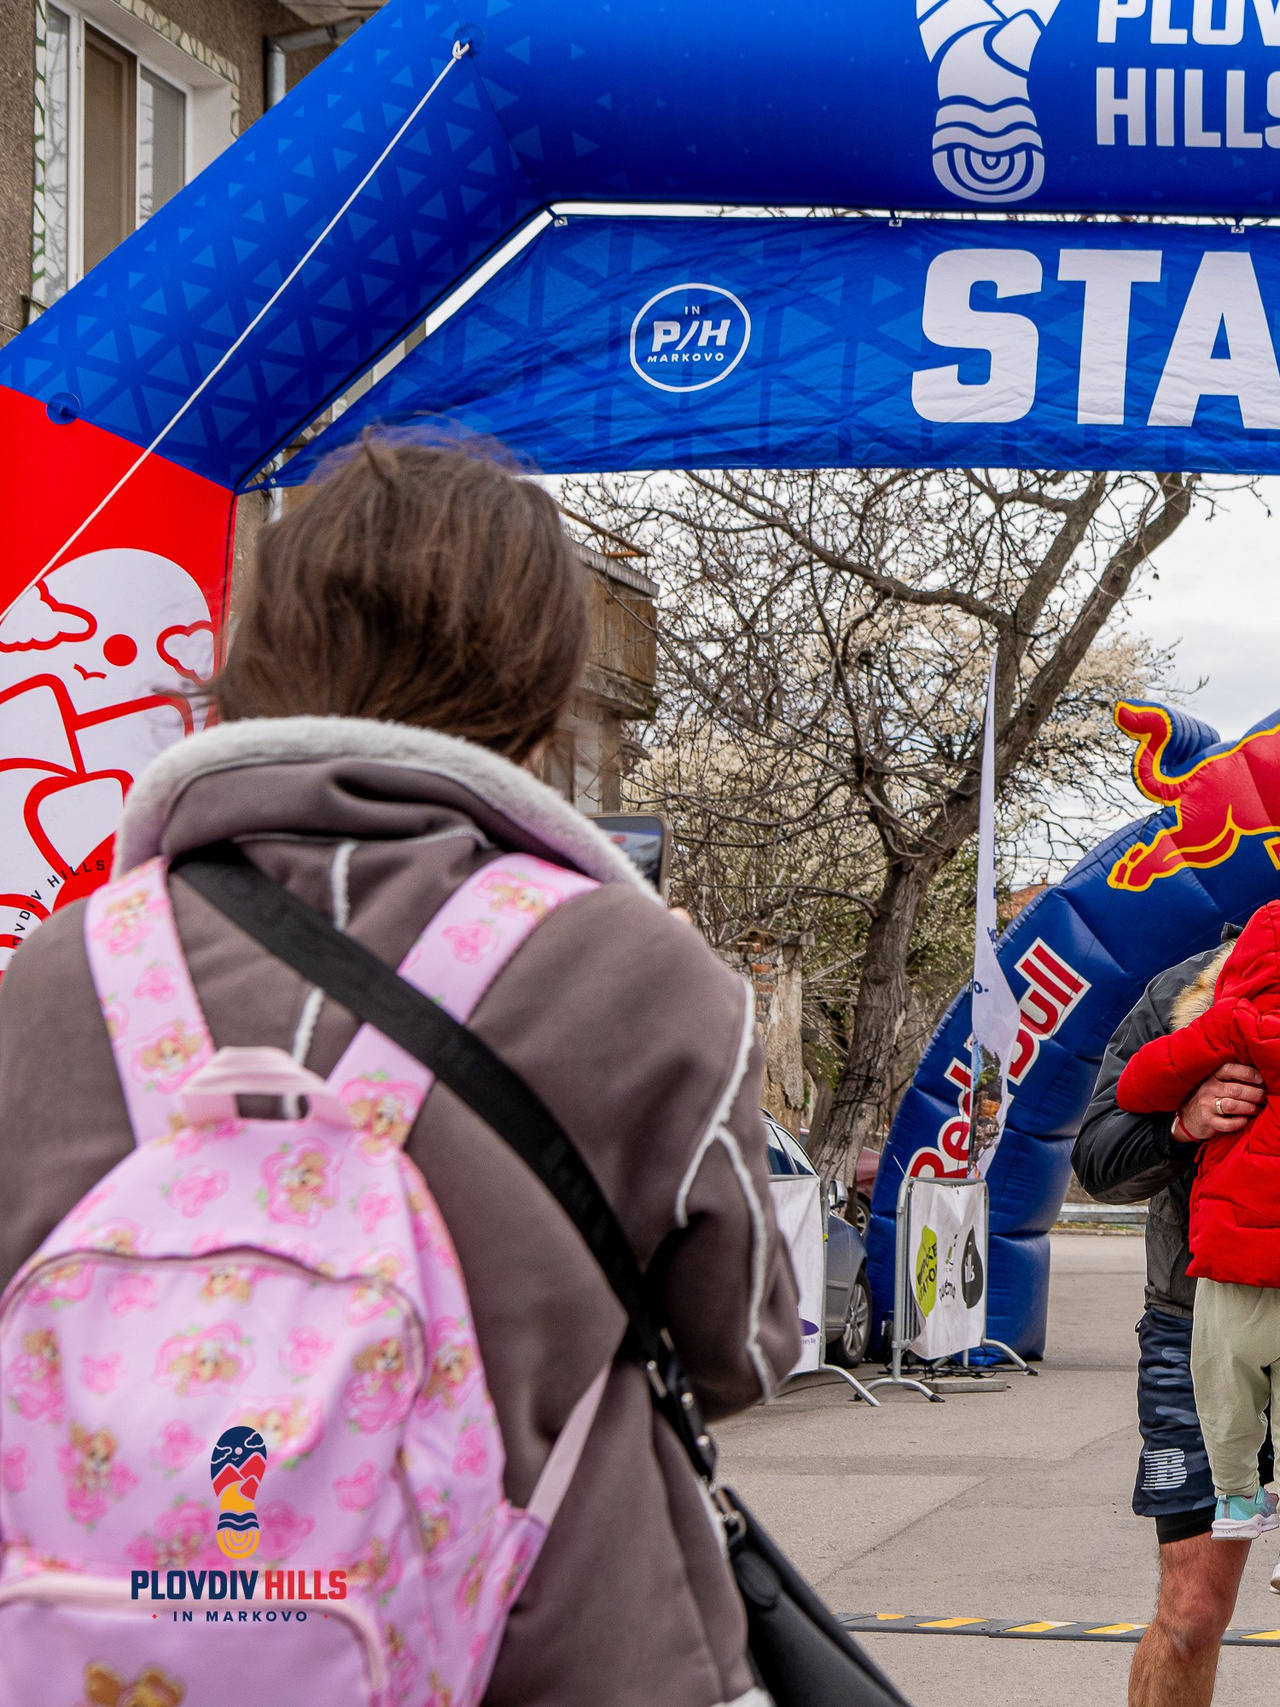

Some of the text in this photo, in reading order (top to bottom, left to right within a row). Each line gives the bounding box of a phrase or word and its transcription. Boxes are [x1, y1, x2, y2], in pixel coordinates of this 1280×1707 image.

[684, 306, 700, 315] IN
[652, 319, 731, 352] P/H
[647, 352, 725, 363] MARKOVO
[12, 859, 105, 947] OVDIV HILLS
